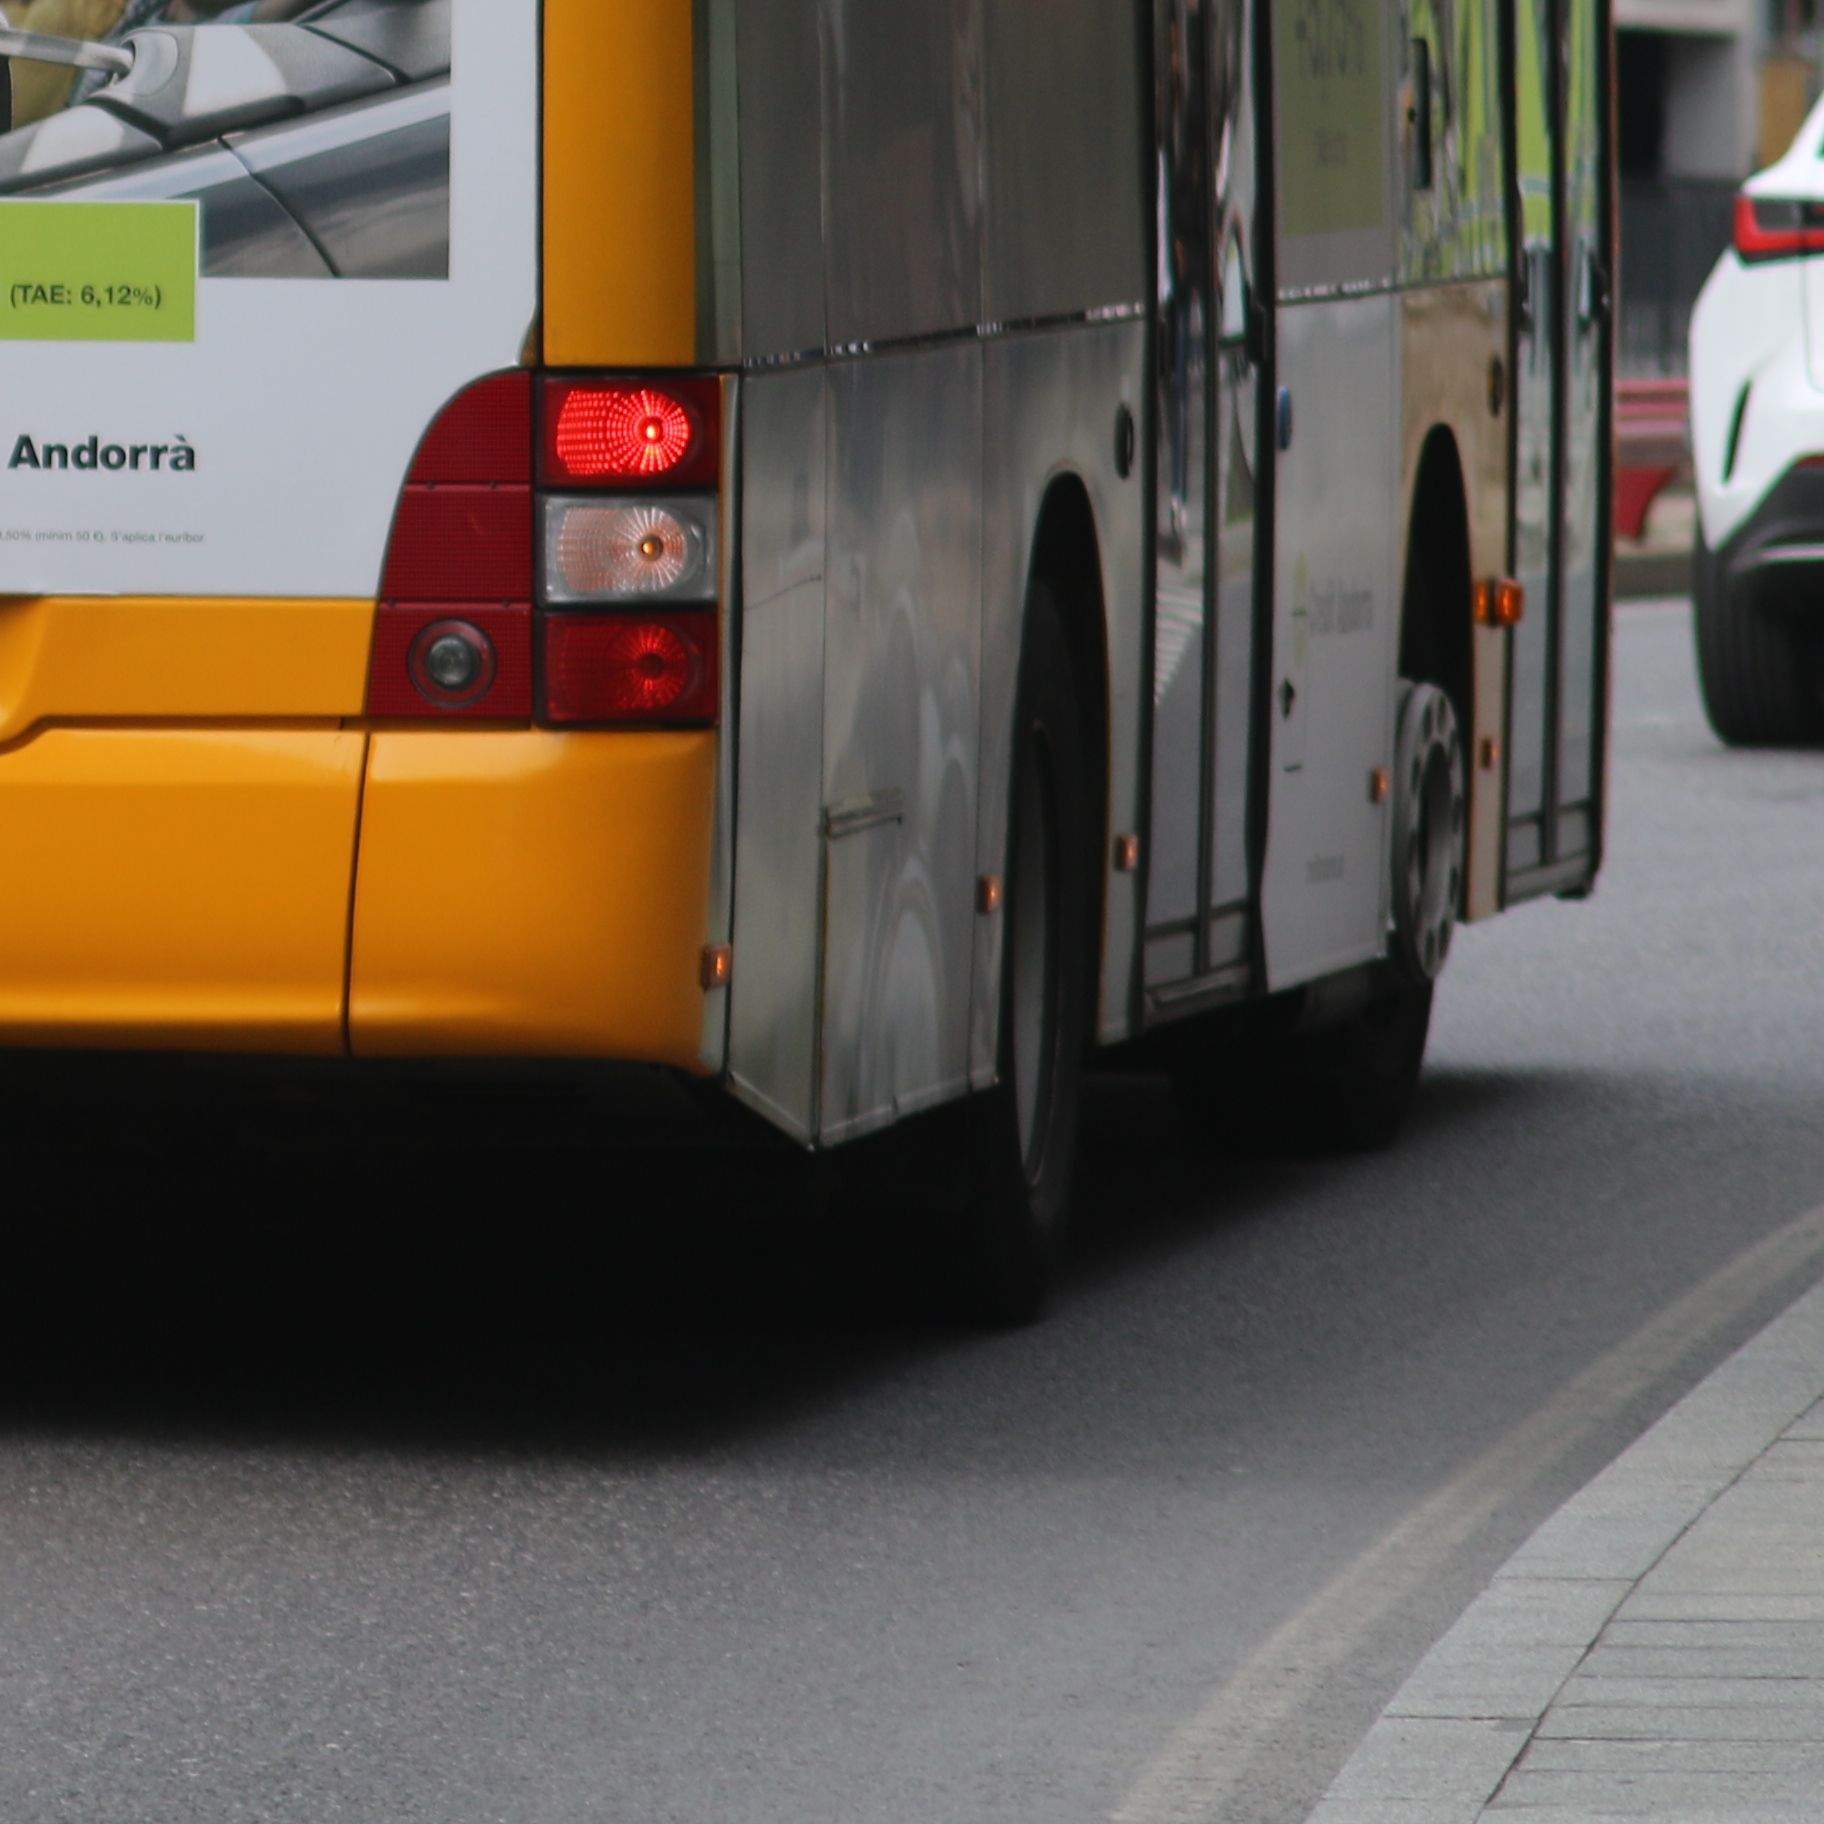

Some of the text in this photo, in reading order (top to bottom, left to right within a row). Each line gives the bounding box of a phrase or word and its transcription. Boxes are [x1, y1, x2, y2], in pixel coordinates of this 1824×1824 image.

[9, 285, 73, 309] (TAE:
[80, 285, 163, 310] 6,12%)
[7, 434, 196, 472] Andorrà
